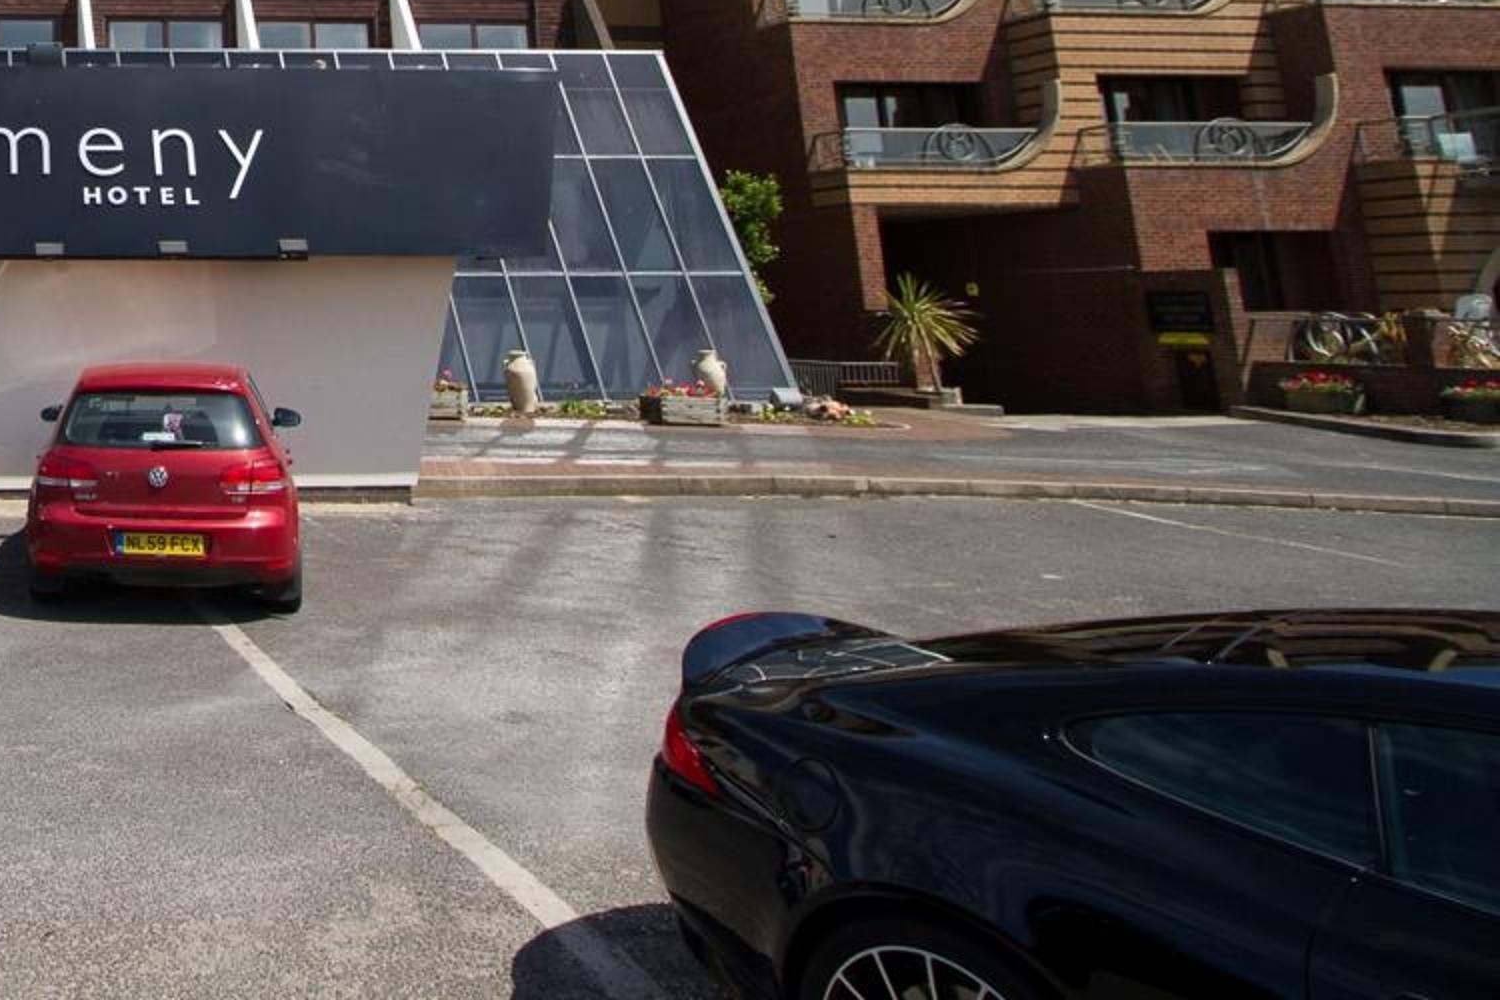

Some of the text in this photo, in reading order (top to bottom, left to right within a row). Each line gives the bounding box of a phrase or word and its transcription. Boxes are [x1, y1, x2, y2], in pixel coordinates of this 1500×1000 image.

[83, 186, 200, 206] HOTEL
[126, 535, 201, 553] NL59 FCX
